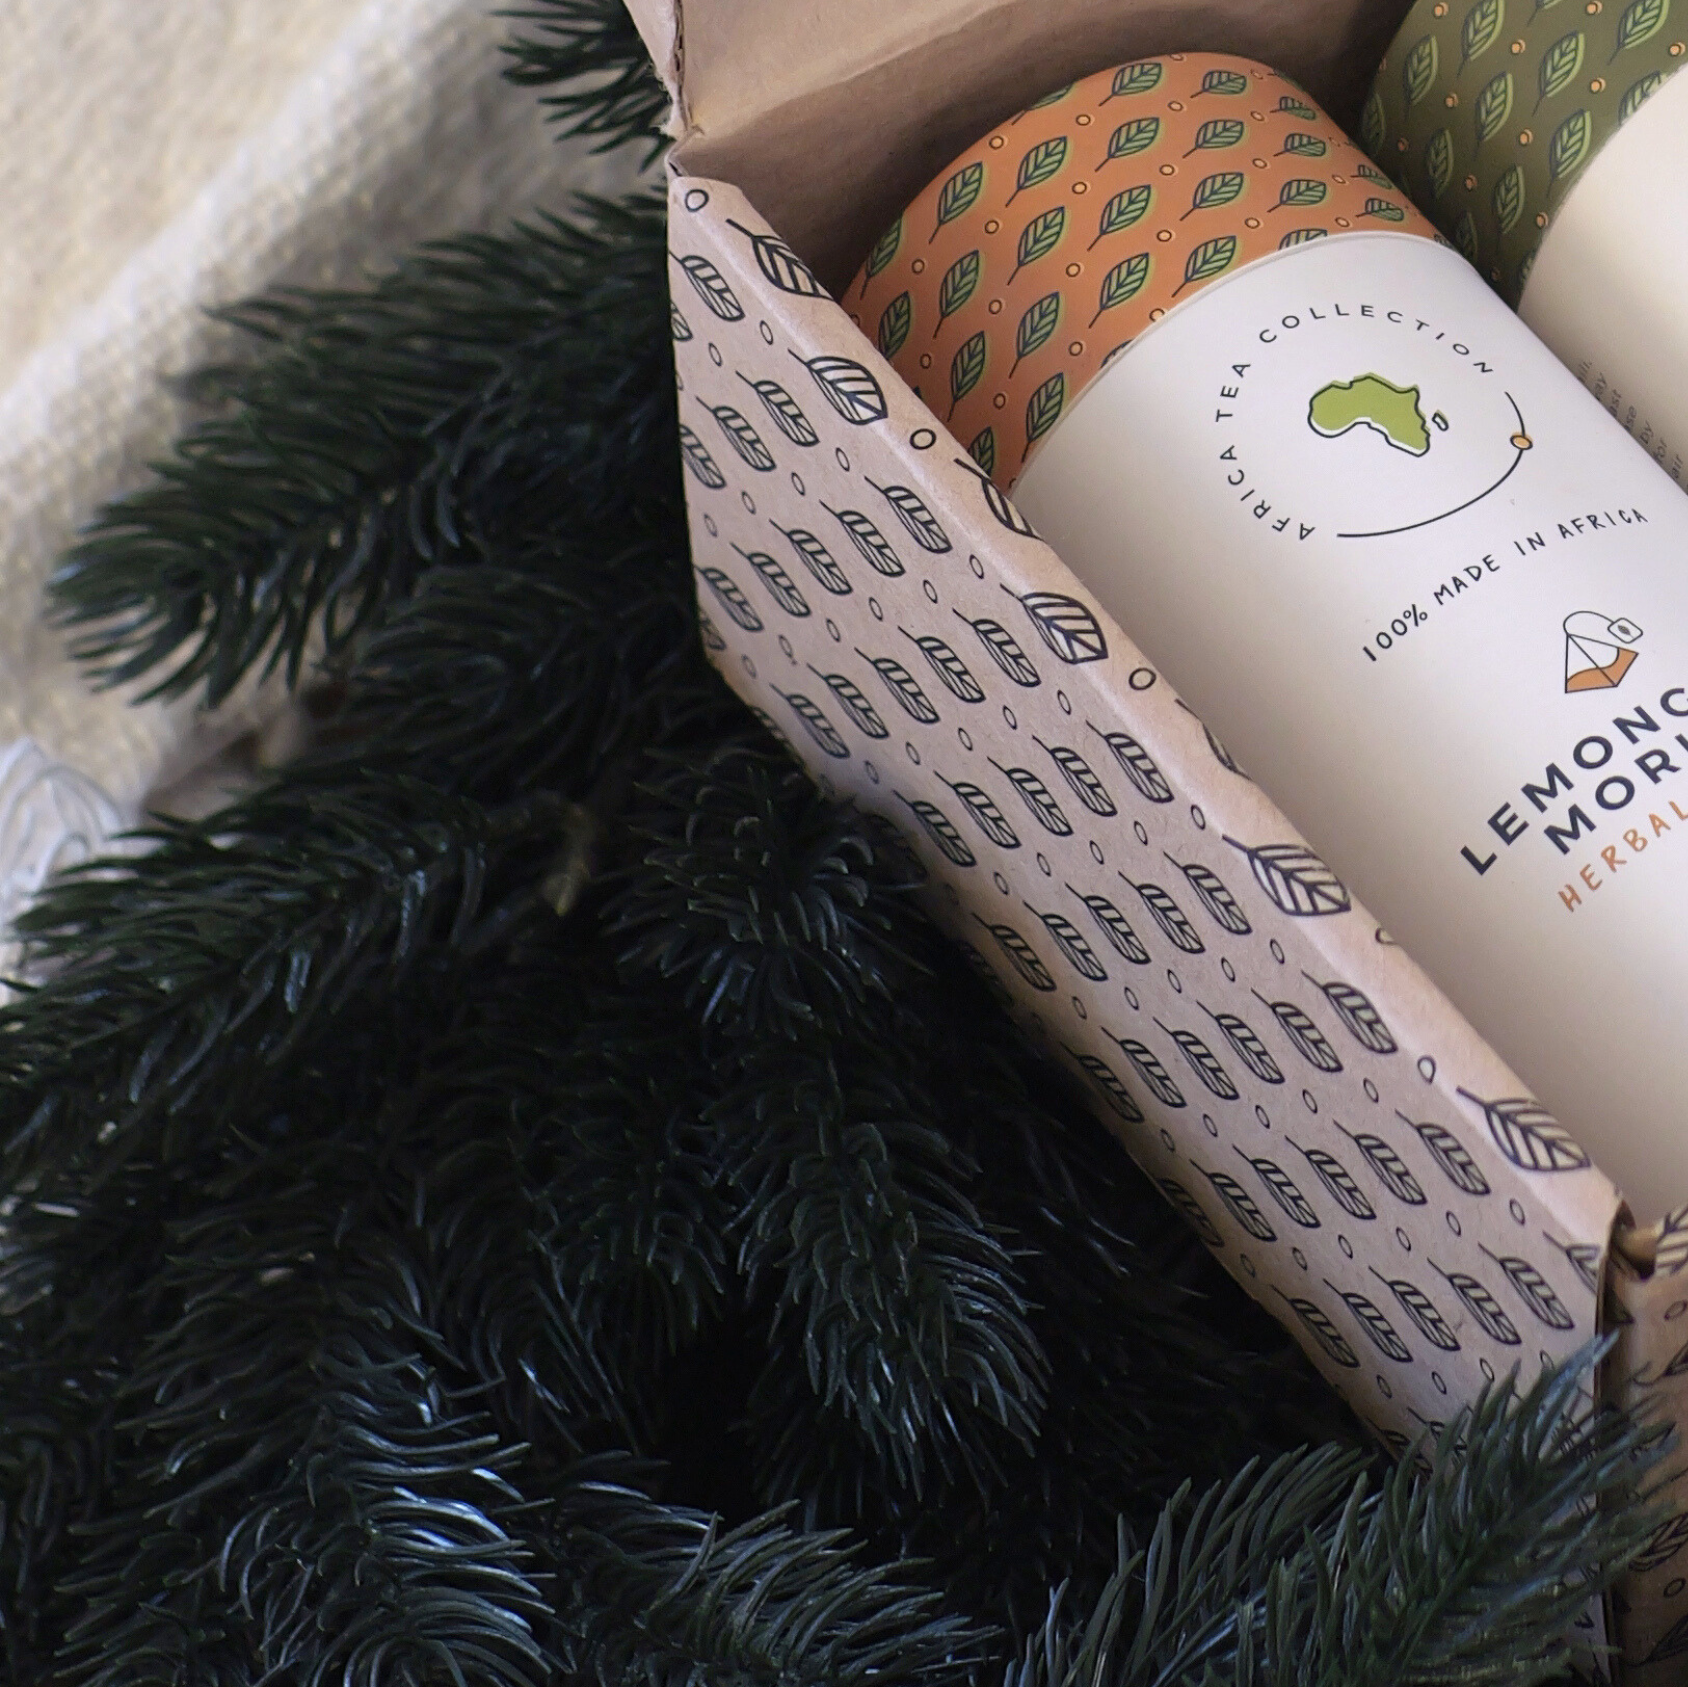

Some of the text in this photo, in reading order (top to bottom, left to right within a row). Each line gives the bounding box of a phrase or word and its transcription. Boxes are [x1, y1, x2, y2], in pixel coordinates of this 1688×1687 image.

[1216, 303, 1493, 540] AFRICA TEA COLLECTION
[1363, 509, 1648, 662] 100% MADE IN AFRICA
